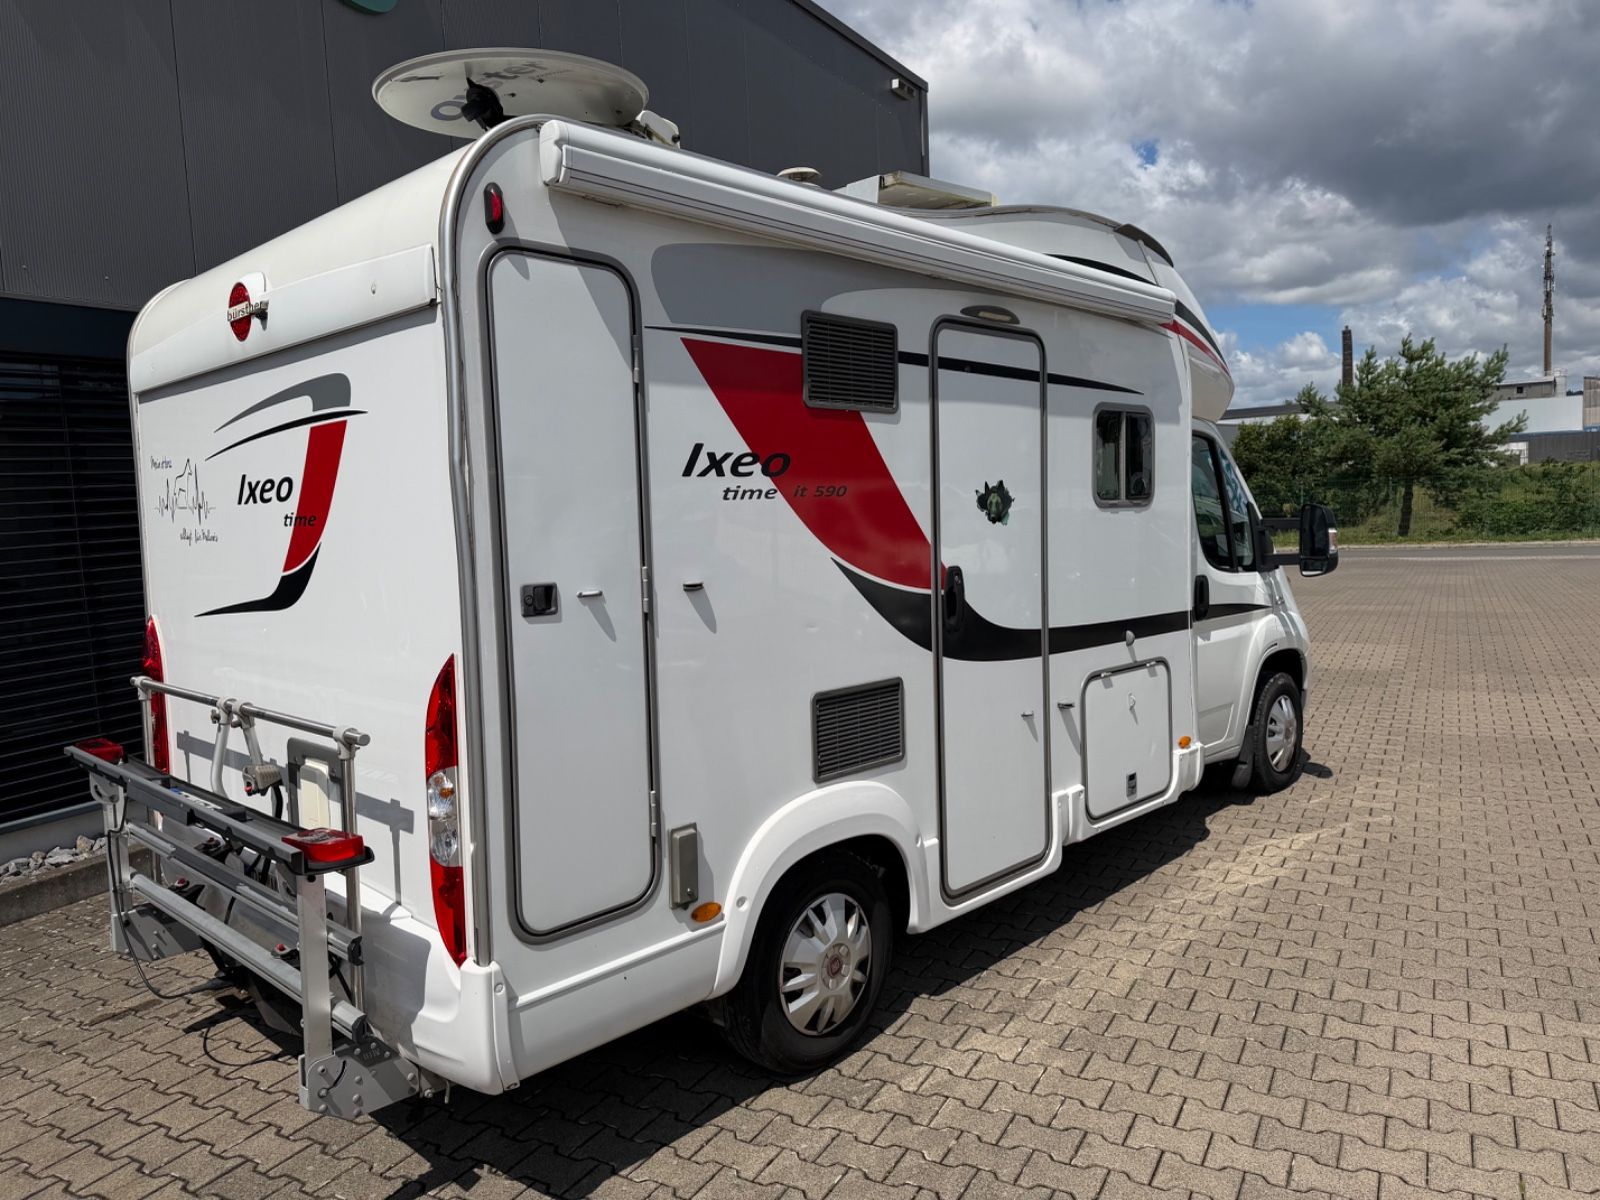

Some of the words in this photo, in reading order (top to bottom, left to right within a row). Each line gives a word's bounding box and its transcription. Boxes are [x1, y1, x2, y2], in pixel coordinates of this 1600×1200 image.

[681, 442, 791, 478] Ixeo
[237, 473, 294, 505] Ixeo
[722, 485, 778, 501] time
[793, 484, 809, 498] it
[813, 485, 848, 498] 590
[283, 511, 318, 528] time
